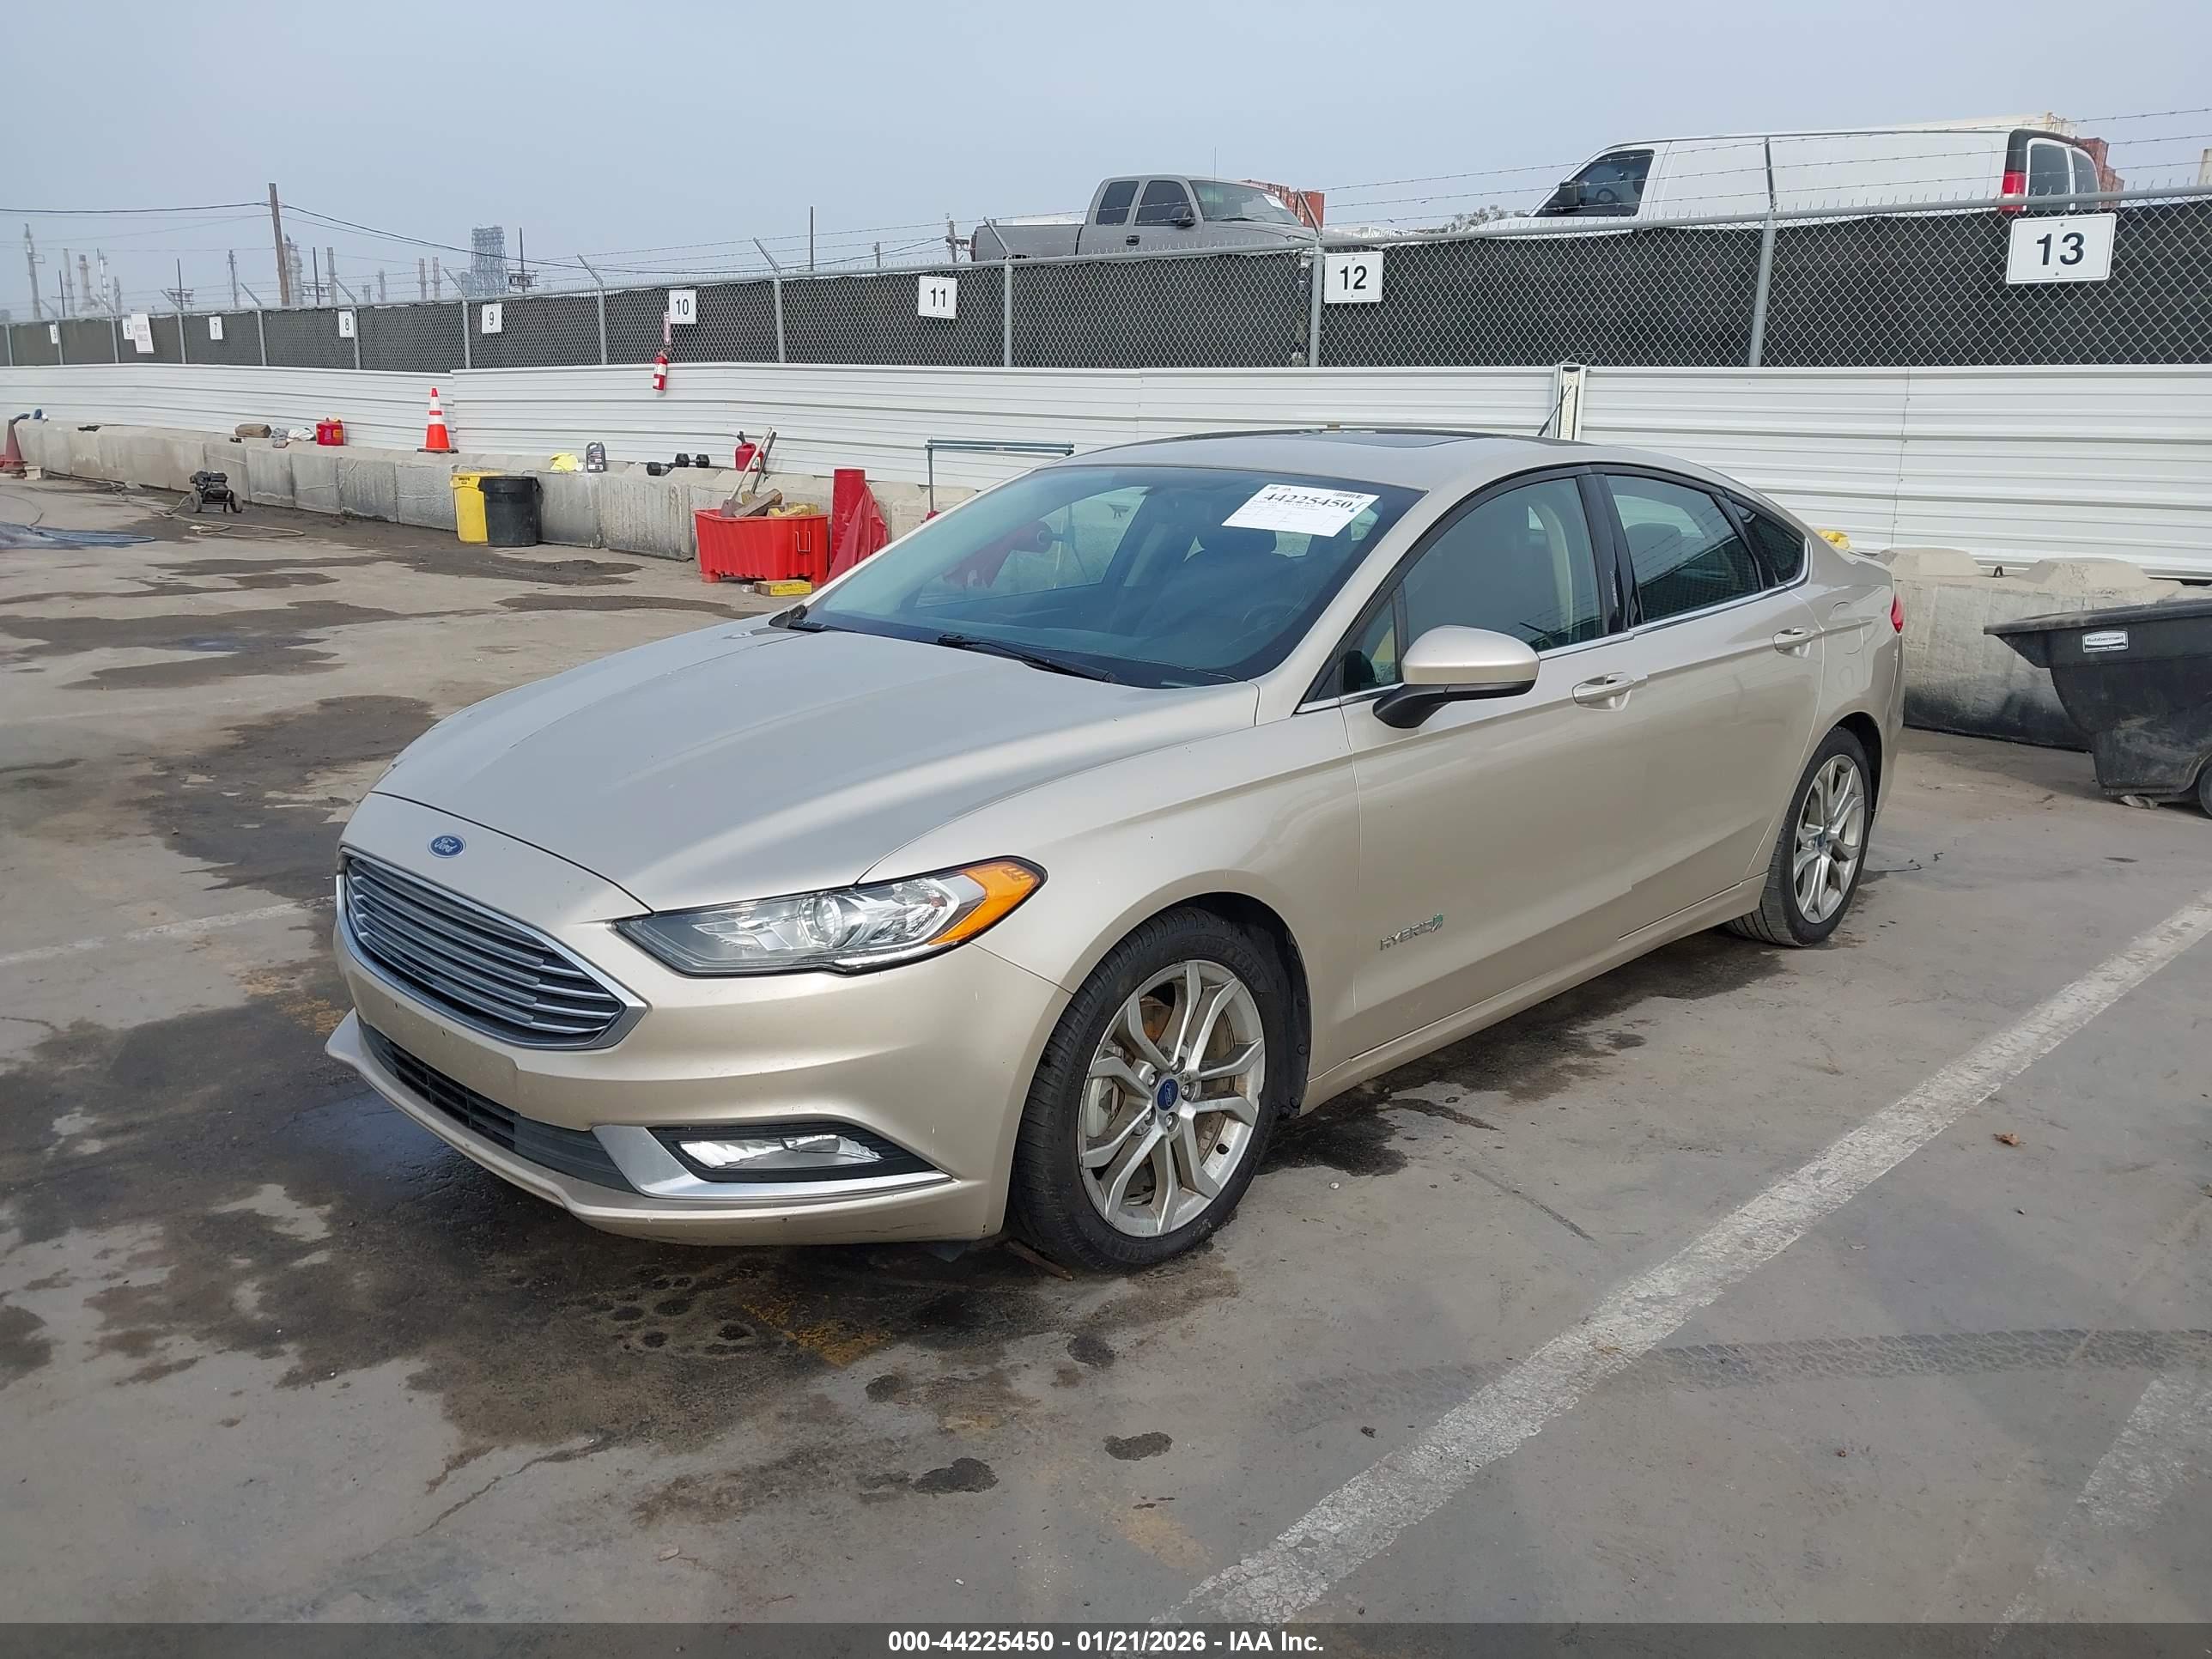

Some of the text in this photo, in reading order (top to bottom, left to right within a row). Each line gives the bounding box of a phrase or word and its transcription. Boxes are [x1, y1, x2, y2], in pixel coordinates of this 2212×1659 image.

[2036, 232, 2085, 266] 13
[1340, 264, 1367, 290] 12
[930, 287, 946, 307] 11
[676, 298, 690, 316] 10
[344, 317, 349, 331] 8
[489, 311, 495, 326] 9
[214, 322, 218, 333] 7
[1563, 376, 1575, 440] SPIL
[1264, 492, 1353, 509] 44225450
[434, 836, 458, 853] Ford
